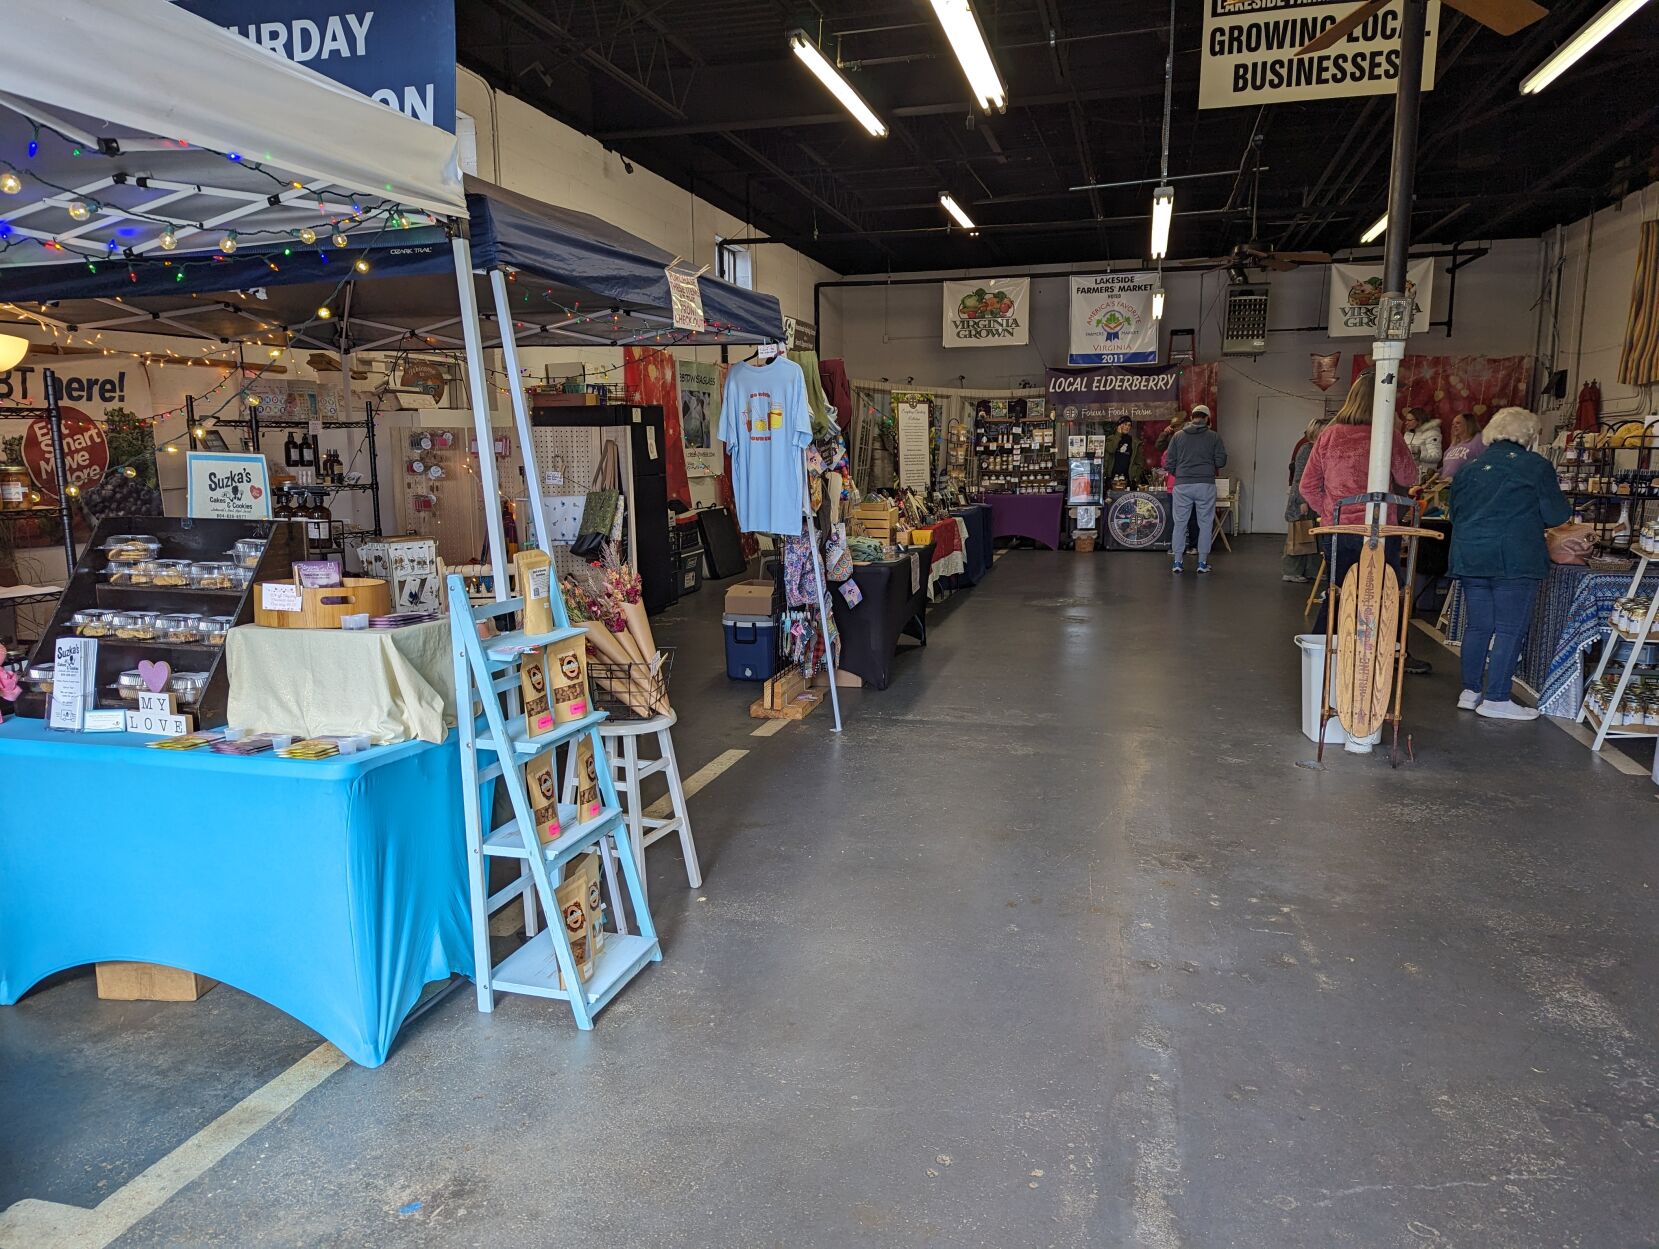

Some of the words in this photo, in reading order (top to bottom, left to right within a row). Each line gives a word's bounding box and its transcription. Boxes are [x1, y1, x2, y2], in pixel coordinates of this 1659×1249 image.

[1233, 49, 1400, 92] BUSINESSES
[1095, 276, 1135, 284] LAKESIDE
[1076, 286, 1117, 294] FARMERS'
[1118, 284, 1154, 292] MARKET
[1087, 300, 1116, 326] AMERICA'S
[1116, 300, 1141, 324] FAVORITE
[952, 318, 1021, 330] VIRGINIA
[956, 328, 1015, 340] GROWN
[1102, 354, 1124, 363] 2011
[43, 367, 126, 402] here!
[1049, 376, 1088, 392] LOCAL
[1092, 374, 1176, 391] ELDERBERRY
[1082, 408, 1106, 418] Forever
[1108, 407, 1128, 417] Foods
[1131, 408, 1152, 416] Farm
[33, 420, 70, 442] Et
[39, 450, 90, 480] Mve
[208, 468, 252, 492] Suzka's
[57, 644, 80, 660] Suzka's
[140, 696, 166, 711] MY
[130, 716, 182, 734] LOVE
